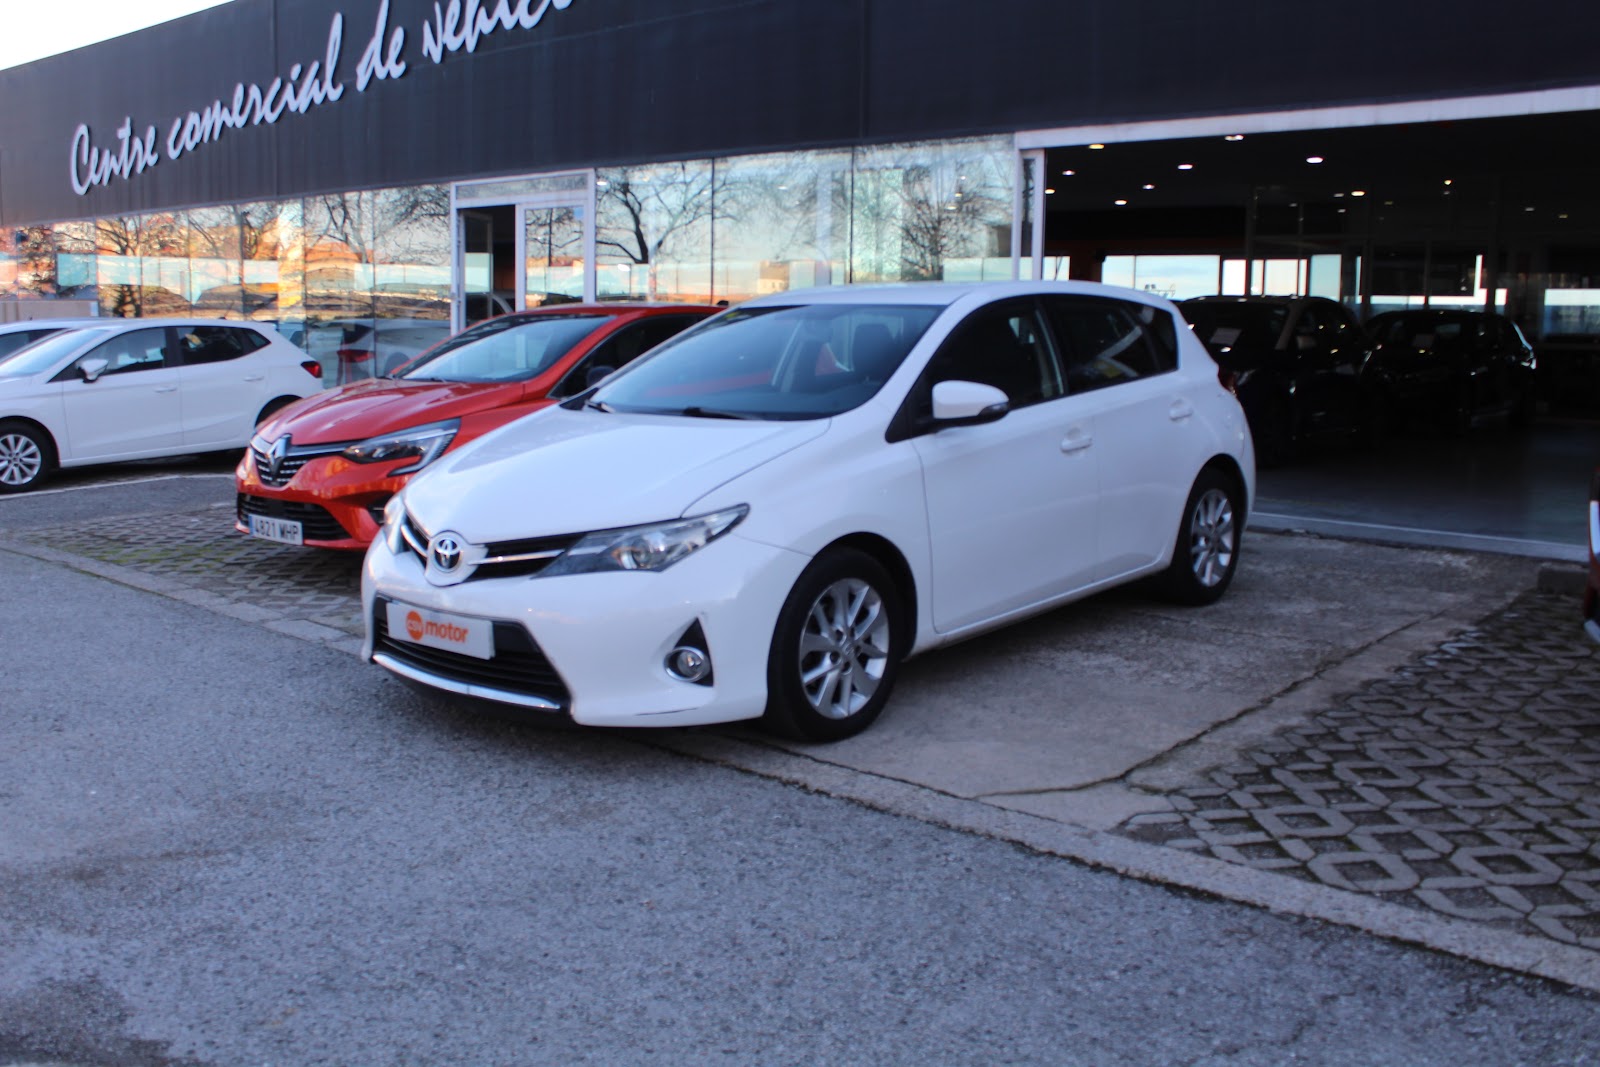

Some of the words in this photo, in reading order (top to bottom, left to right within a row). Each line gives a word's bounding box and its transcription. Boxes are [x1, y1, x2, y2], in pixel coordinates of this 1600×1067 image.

[70, 116, 159, 196] Centre
[167, 12, 345, 160] comercial
[356, 0, 407, 92] de
[425, 620, 469, 643] motor
